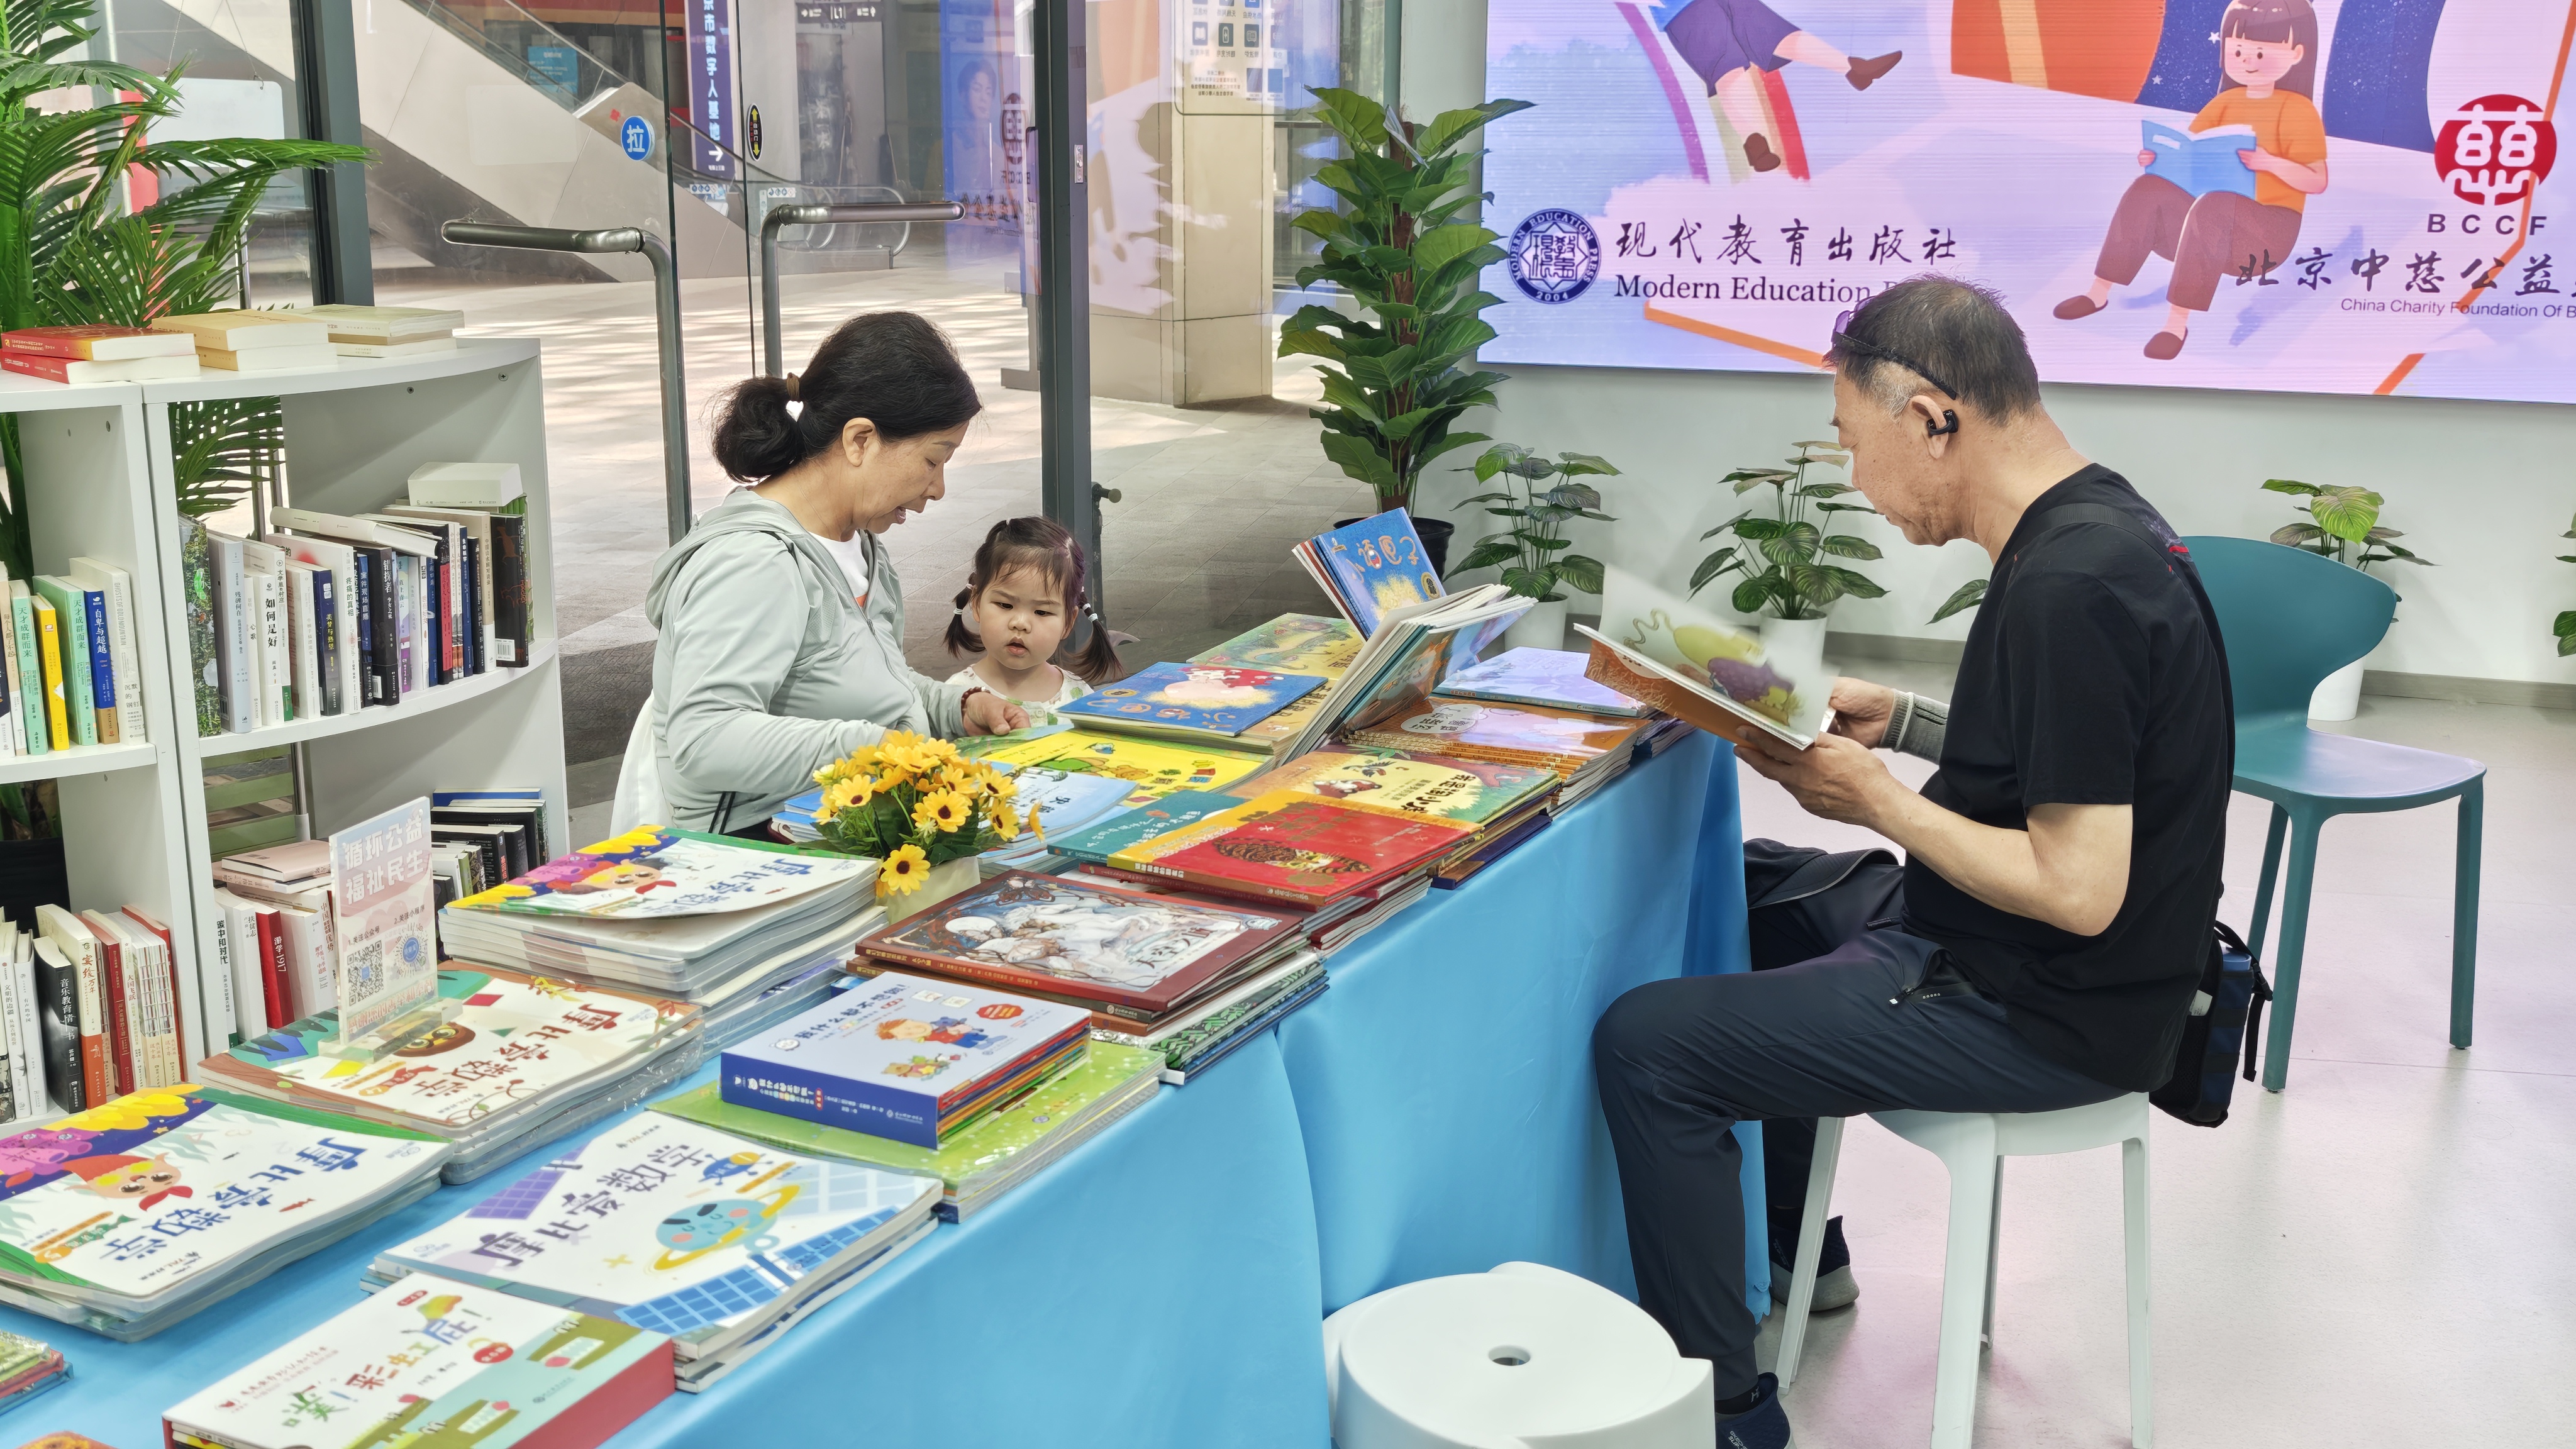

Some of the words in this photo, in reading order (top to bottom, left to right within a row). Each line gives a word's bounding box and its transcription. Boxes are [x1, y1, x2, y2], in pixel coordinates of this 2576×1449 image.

[626, 125, 645, 153] 拉
[1529, 212, 1594, 242] EDUCATION
[1616, 214, 1958, 267] 现代教育出版社
[2428, 213, 2547, 235] BCCF
[1510, 229, 1526, 281] MODERN
[1583, 247, 1599, 283] PRESS
[2236, 248, 2576, 296] 北京中慈公益
[1536, 291, 1568, 301] 2004
[1614, 274, 1721, 301] Modern
[1730, 277, 1872, 304] Education
[2341, 297, 2385, 313] China
[2390, 299, 2445, 318] Charity
[2452, 301, 2538, 317] Foundation
[2543, 303, 2562, 317] Of
[235, 591, 243, 617] 残碑何在
[346, 577, 354, 617] 疼痛的真相
[360, 572, 369, 621] 案件现场直播
[18, 606, 32, 658] 天才成群而来
[73, 599, 86, 650] 天才成群而来
[94, 609, 107, 654] 自卑与超越
[118, 621, 126, 646] MOUNTAIN
[249, 623, 257, 640] 心歌
[265, 598, 277, 648] 如何是好
[345, 818, 423, 872] 循环公益
[346, 850, 425, 905] 福祉民生
[216, 919, 228, 965] 碳中和时代
[4, 984, 14, 1016] 文明的边疆
[412, 1002, 624, 1099] 摩比爱数学
[99, 1137, 369, 1261] 摩比爱数学
[471, 1143, 709, 1269] 摩比爱数学
